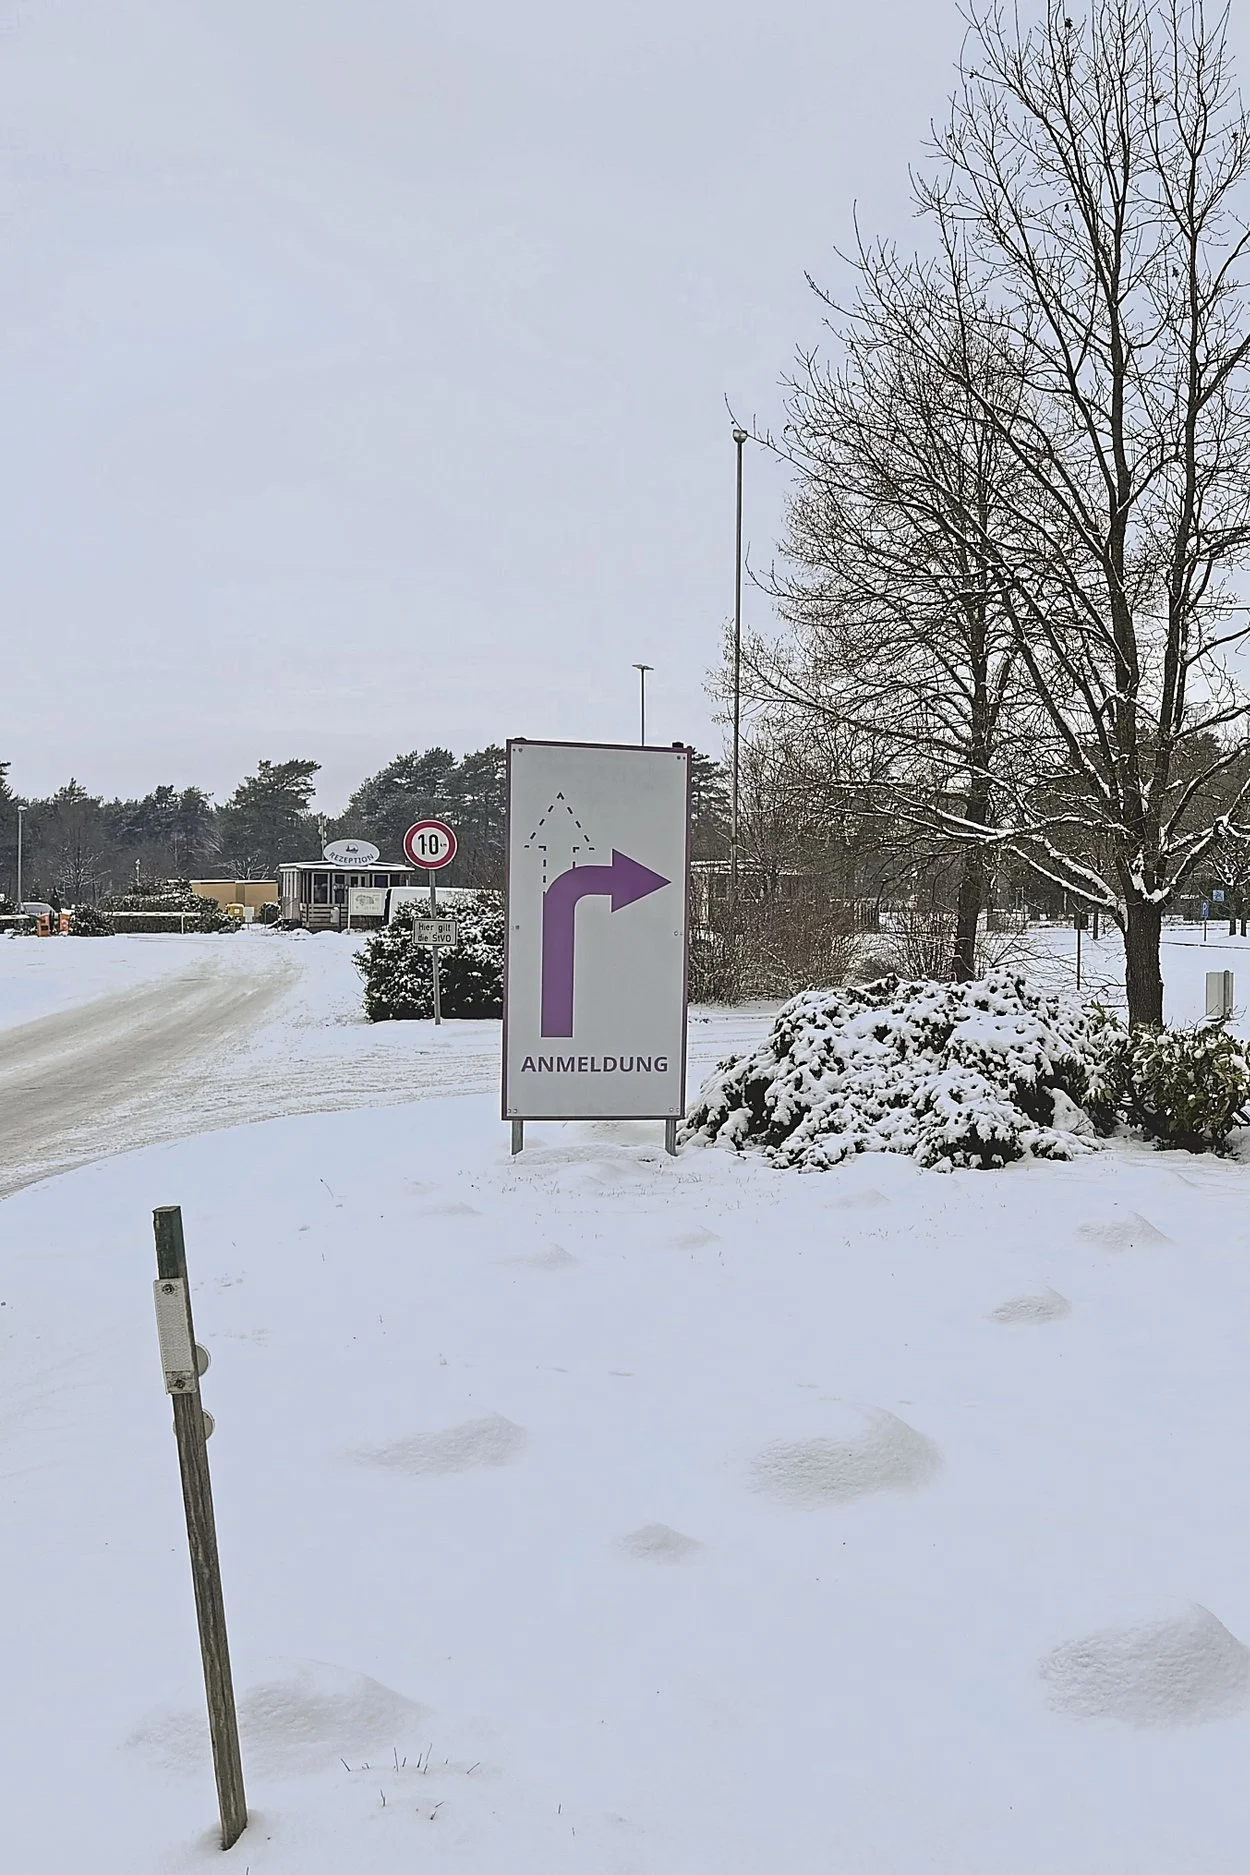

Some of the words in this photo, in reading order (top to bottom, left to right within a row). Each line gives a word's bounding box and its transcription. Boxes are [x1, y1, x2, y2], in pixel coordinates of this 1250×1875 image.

[418, 834, 438, 855] 10
[329, 851, 374, 864] REZEPTION
[418, 922, 434, 931] Hier
[438, 923, 451, 933] gilt
[418, 934, 428, 942] die
[432, 934, 452, 942] StVO
[521, 1056, 668, 1073] ANMELDUNG
